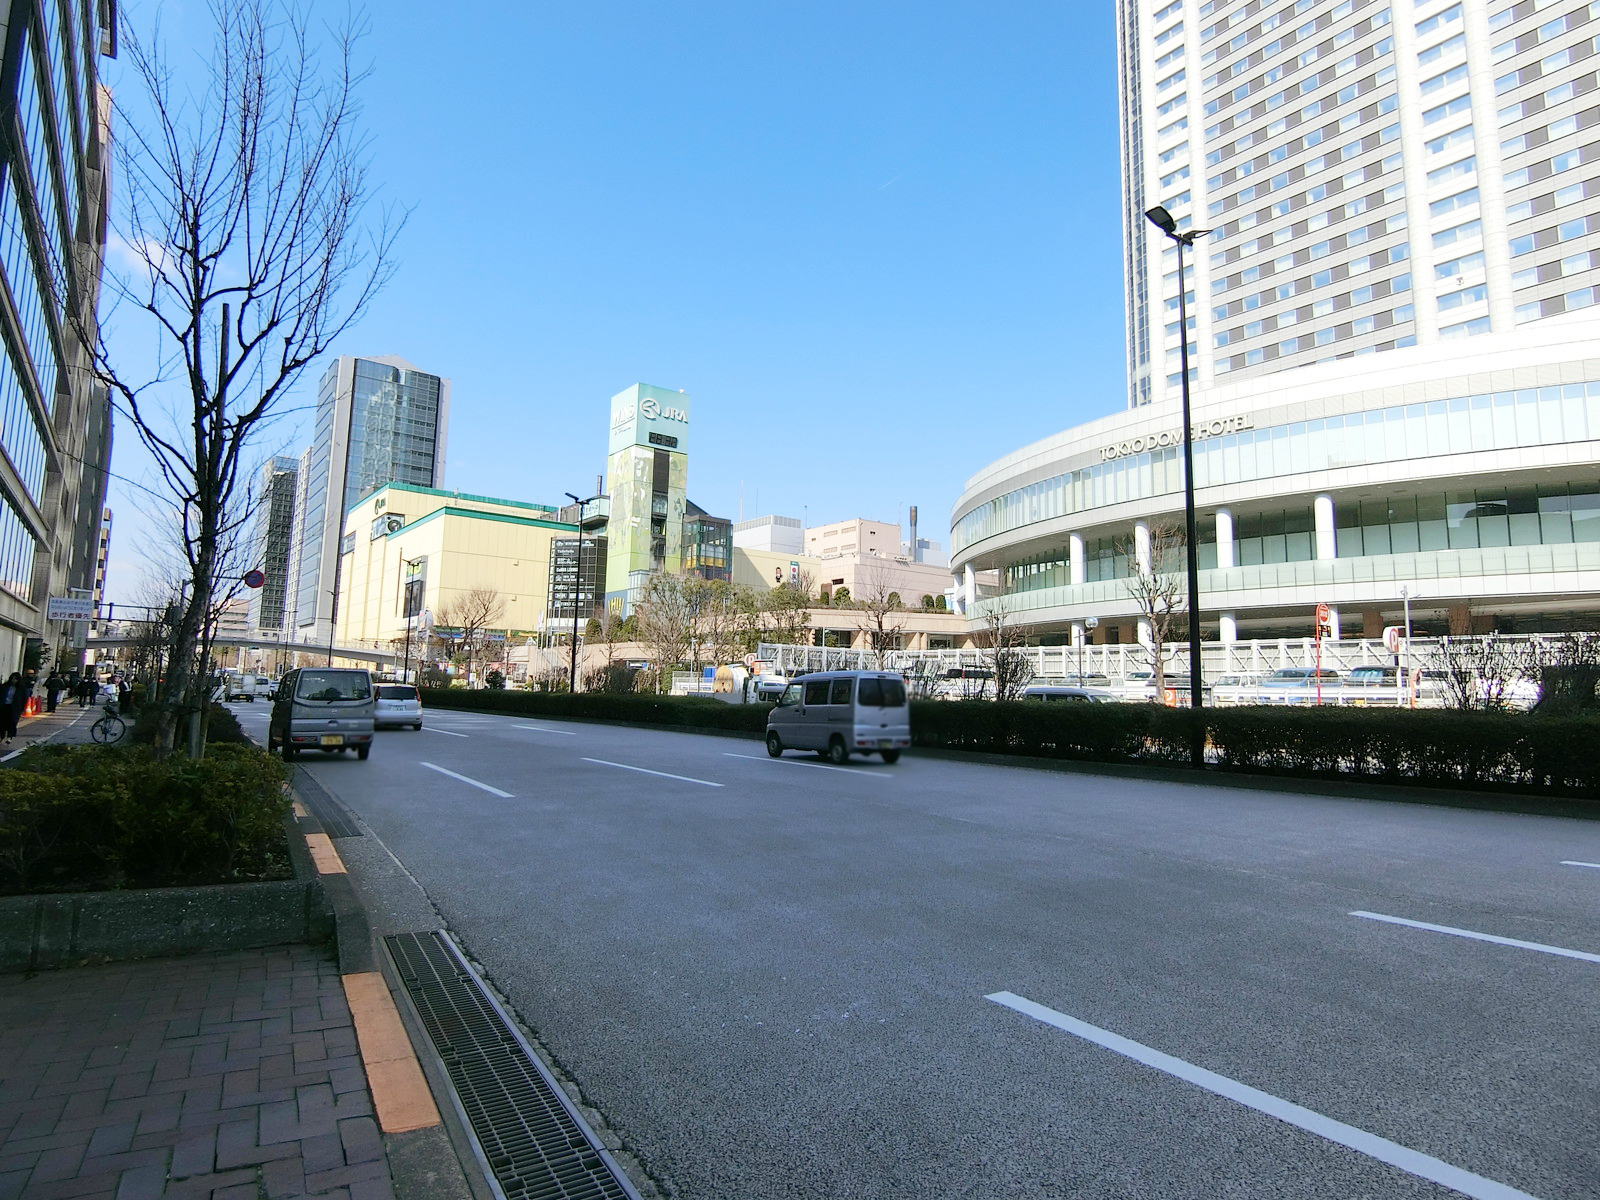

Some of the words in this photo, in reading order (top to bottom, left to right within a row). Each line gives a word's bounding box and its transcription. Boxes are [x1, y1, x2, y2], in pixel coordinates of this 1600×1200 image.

[662, 406, 689, 424] JRA
[1099, 439, 1145, 462] TOKYO
[1146, 426, 1196, 451] DOME
[1197, 413, 1255, 440] HOTEL
